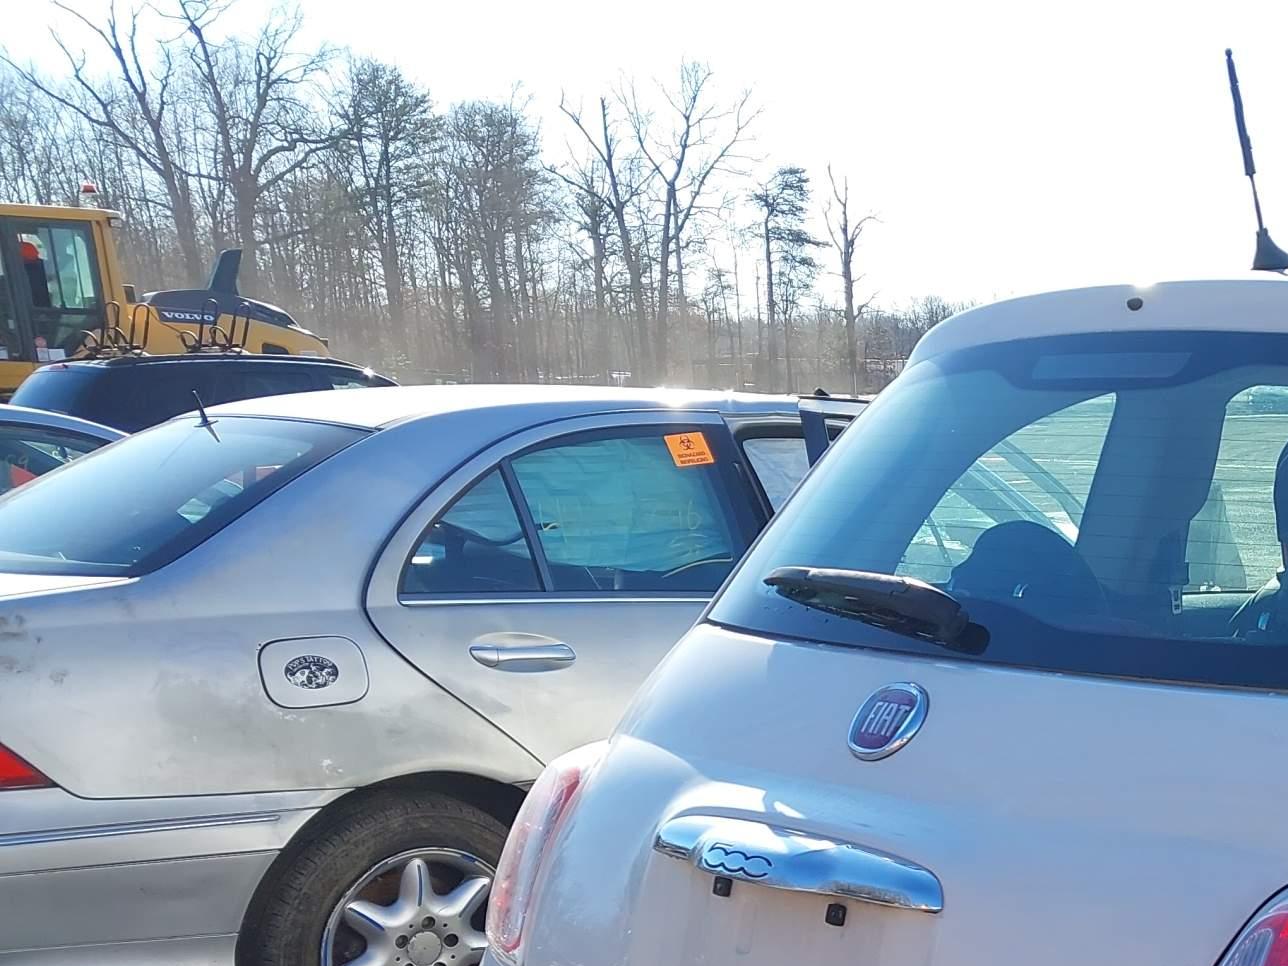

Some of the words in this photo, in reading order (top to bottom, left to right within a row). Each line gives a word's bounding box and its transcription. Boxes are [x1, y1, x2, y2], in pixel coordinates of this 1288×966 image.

[162, 312, 214, 321] VOLVO
[860, 701, 911, 738] FIAT
[703, 842, 773, 879] 500
